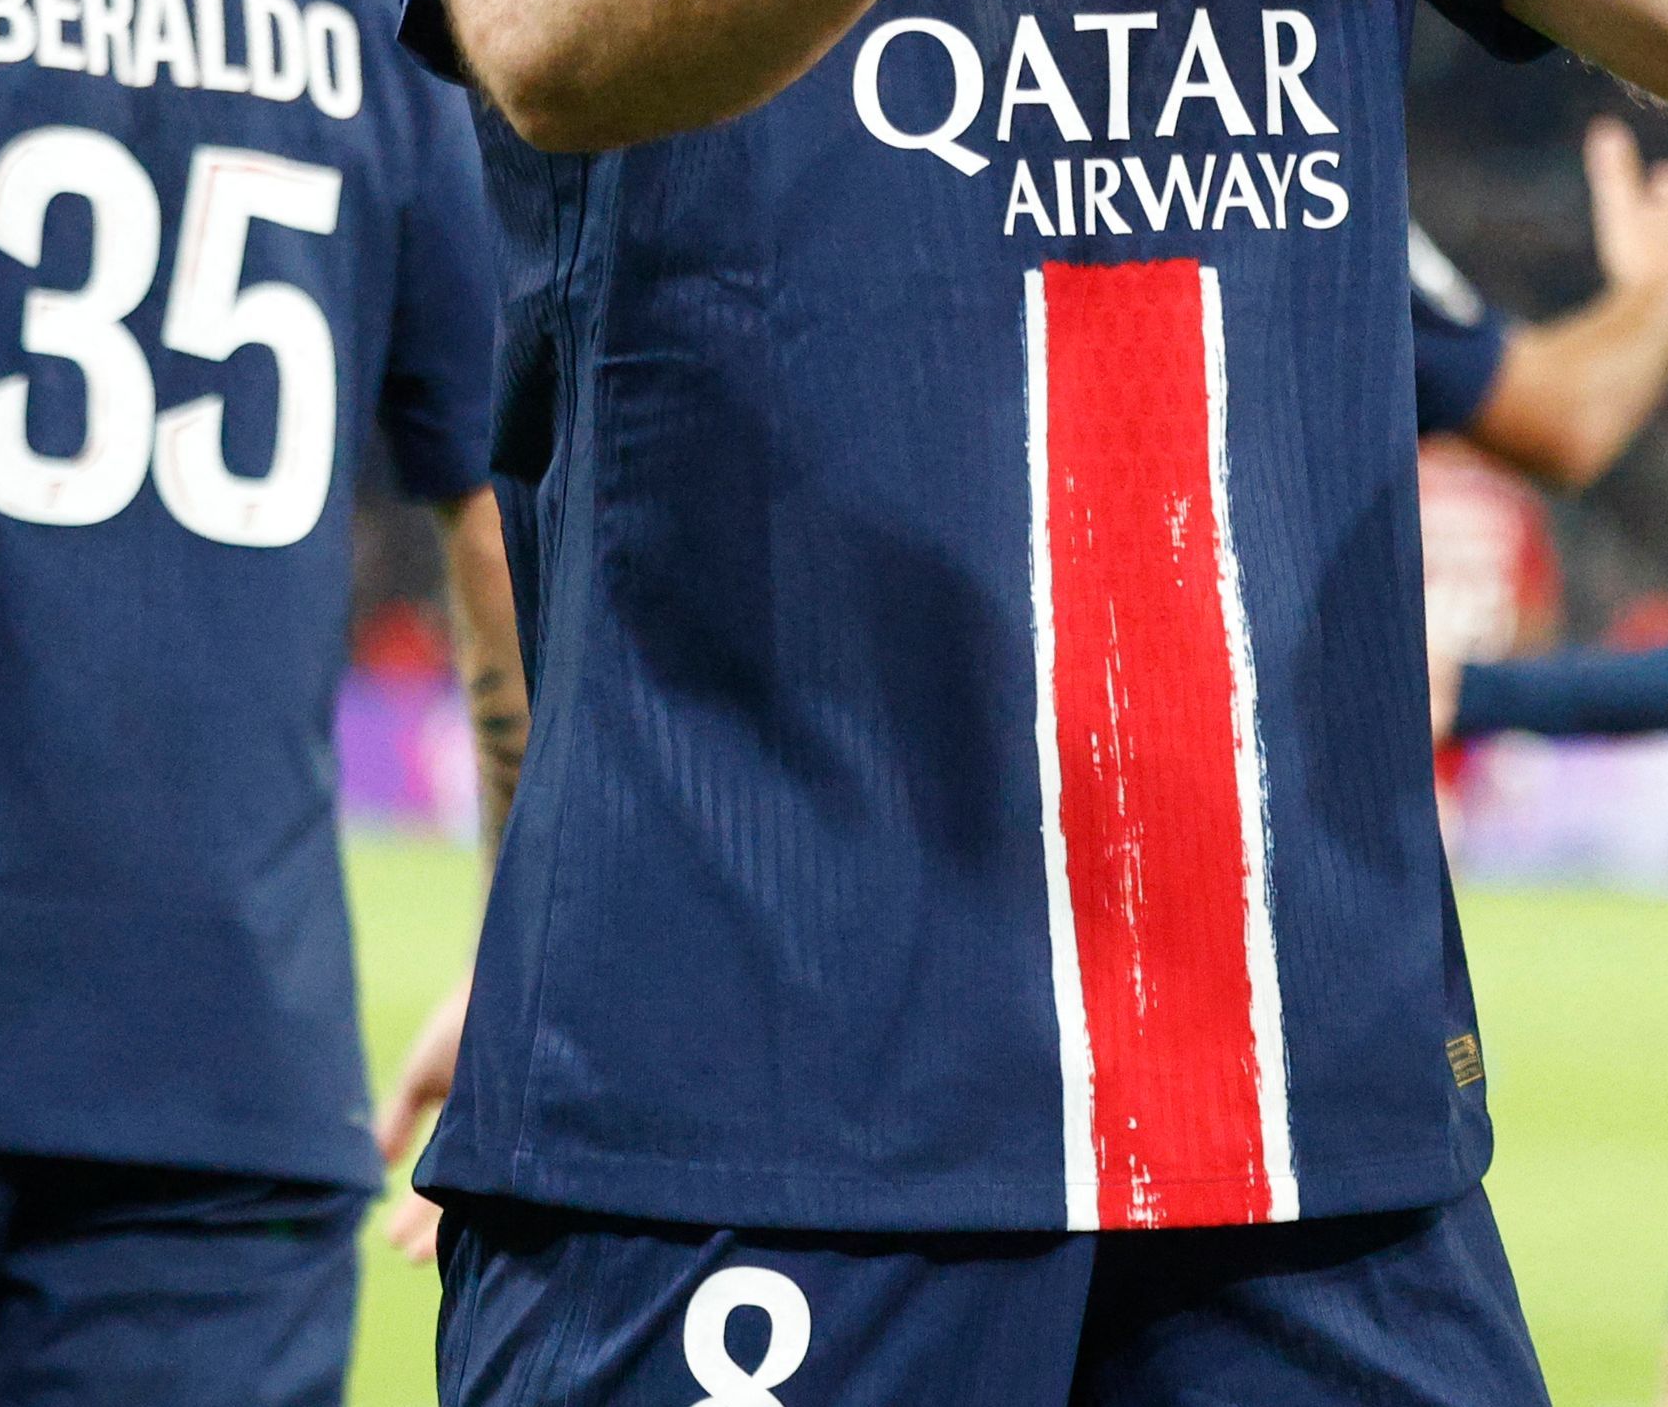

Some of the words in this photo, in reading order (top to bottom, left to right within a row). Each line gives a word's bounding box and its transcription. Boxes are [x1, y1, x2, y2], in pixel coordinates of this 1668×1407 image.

[852, 7, 1341, 177] QATAR
[1003, 150, 1350, 237] AIRWAYS
[683, 1265, 812, 1407] 8
